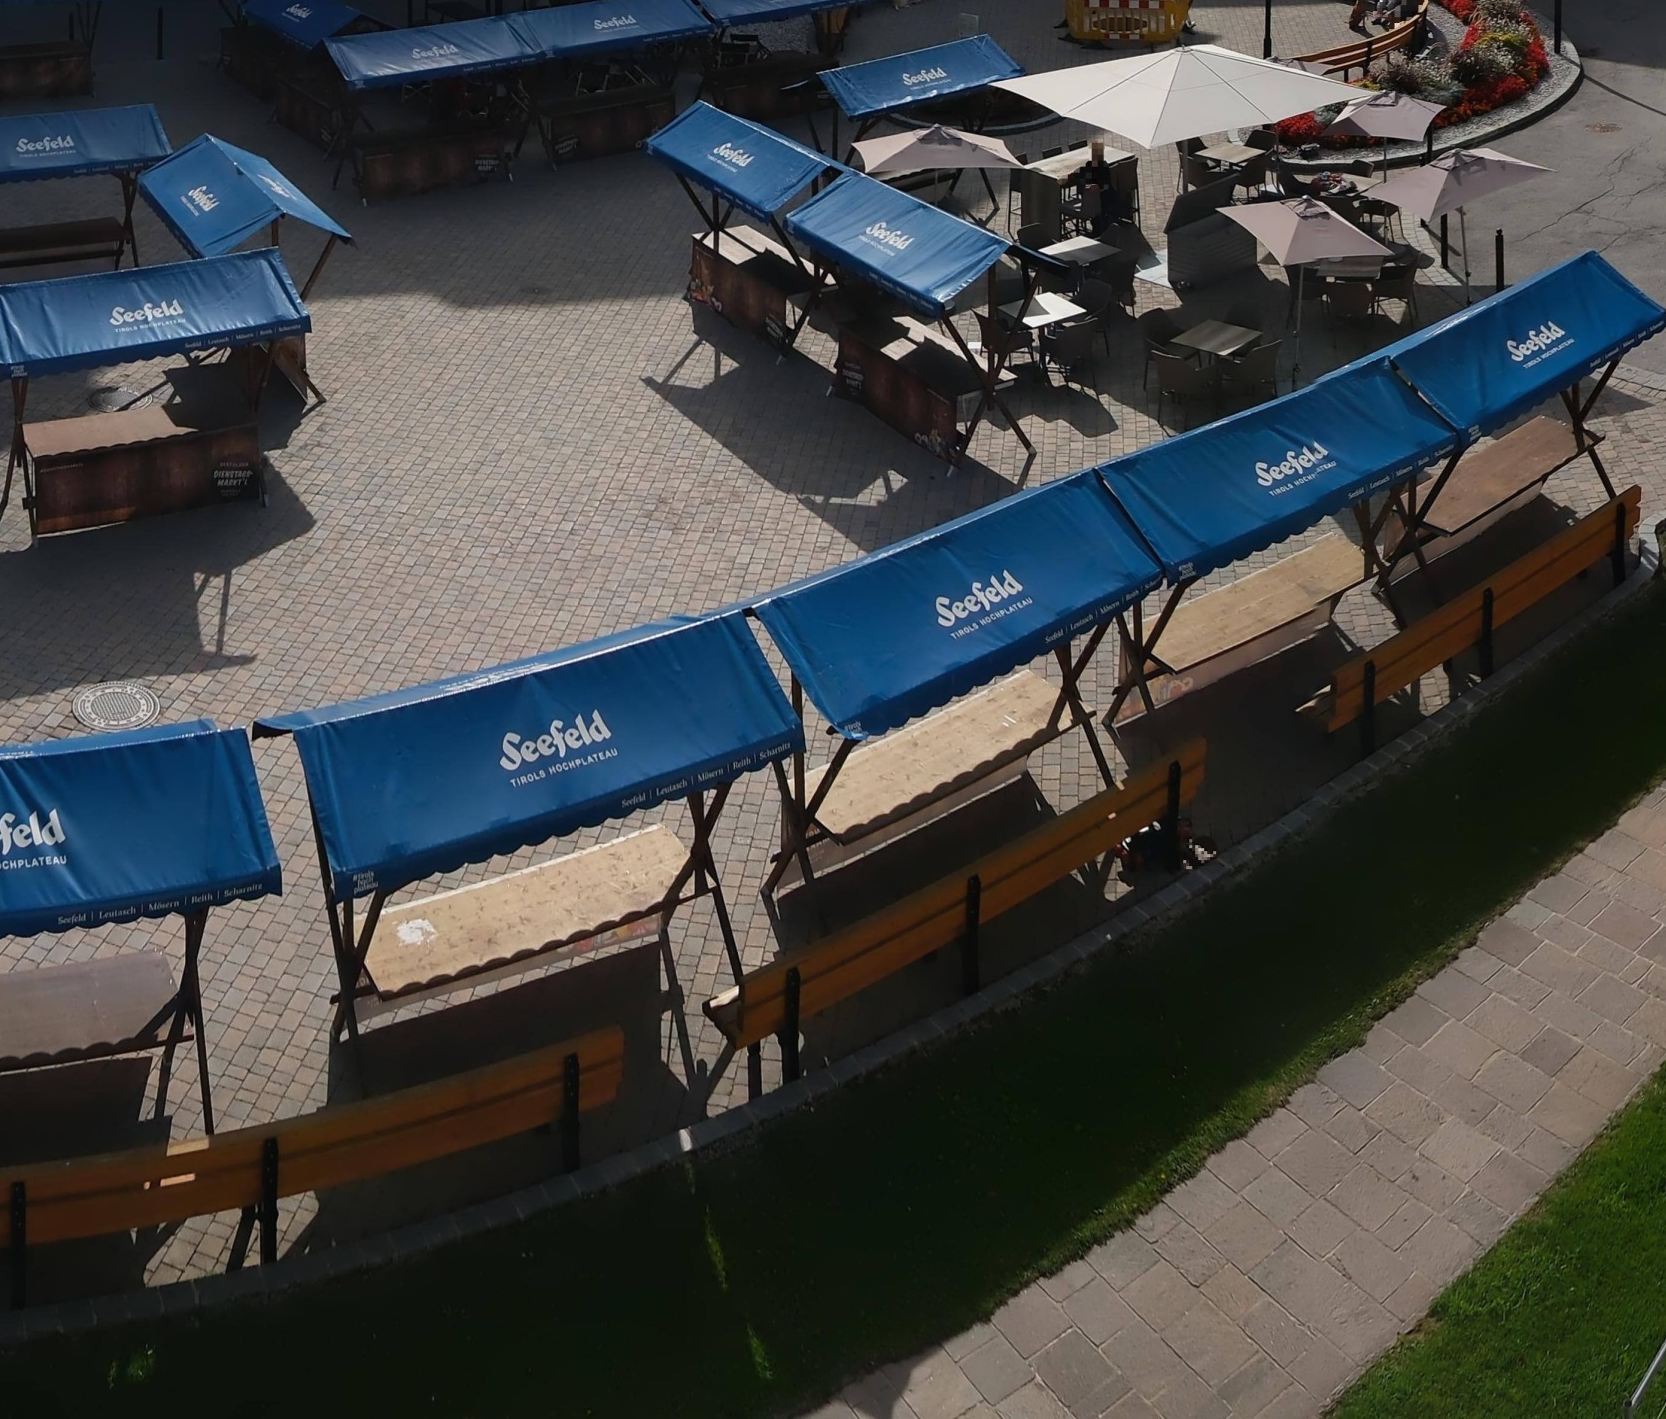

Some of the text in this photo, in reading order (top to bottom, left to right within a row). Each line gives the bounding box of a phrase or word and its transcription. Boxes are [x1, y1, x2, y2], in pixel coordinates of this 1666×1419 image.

[594, 15, 637, 31] Seefeld
[412, 45, 458, 61] Seefeld
[902, 68, 948, 86] Seefeld
[16, 135, 75, 154] Seefeld
[866, 221, 915, 251] Seefeld
[109, 300, 185, 327] Seefeld
[1507, 321, 1566, 363] Seefeld
[1255, 441, 1329, 487] Seefeld
[1269, 483, 1293, 499] TIROLS
[935, 570, 1024, 628] Seefeld
[950, 597, 1034, 641] TIROLS HOCHPLATEAU
[500, 710, 612, 771] Seefeld
[510, 748, 619, 788] TIROLS HOCHPLATEAU
[622, 742, 791, 809] Seefeld Leutasch Mösern Reith Scharnitz
[57, 883, 263, 926] Seefeld Leutasch Mösern Reith Scharnitz
